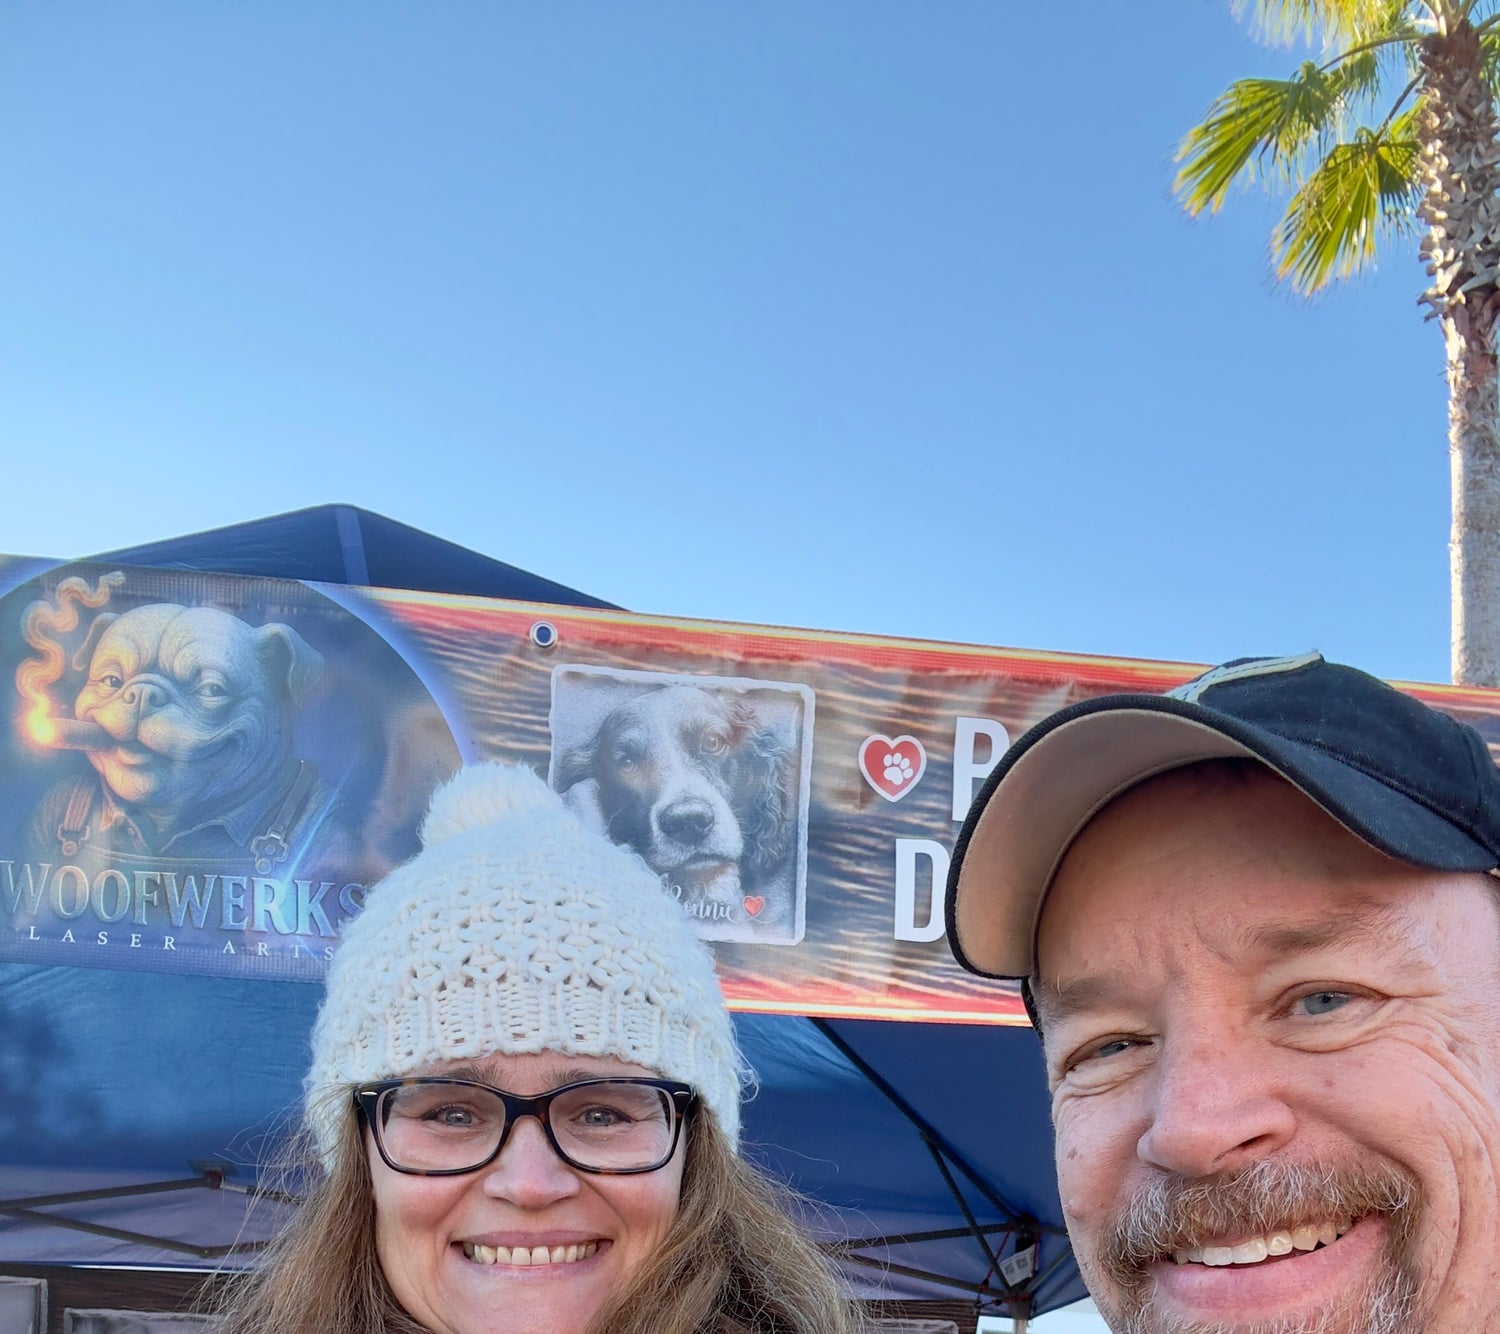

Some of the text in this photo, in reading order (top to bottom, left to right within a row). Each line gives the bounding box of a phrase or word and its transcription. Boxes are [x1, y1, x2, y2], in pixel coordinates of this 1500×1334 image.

[0, 860, 367, 938] WOOFWERKS
[29, 926, 335, 961] LASER ARTS
